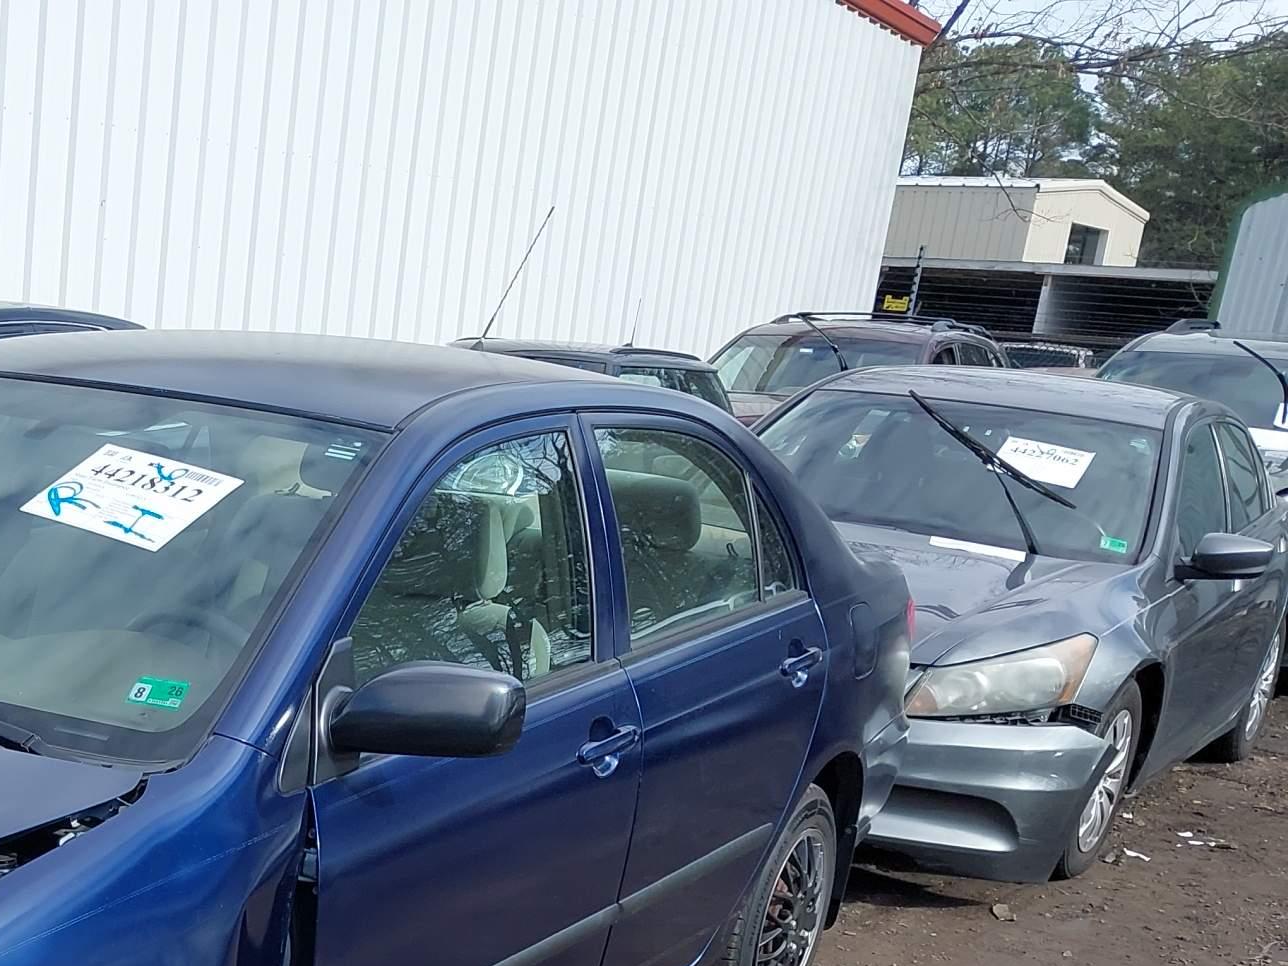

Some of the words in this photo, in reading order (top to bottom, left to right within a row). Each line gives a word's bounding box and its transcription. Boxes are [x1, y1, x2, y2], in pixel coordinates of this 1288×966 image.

[91, 463, 204, 503] 44218312
[134, 687, 145, 698] 8
[168, 686, 184, 697] 26
